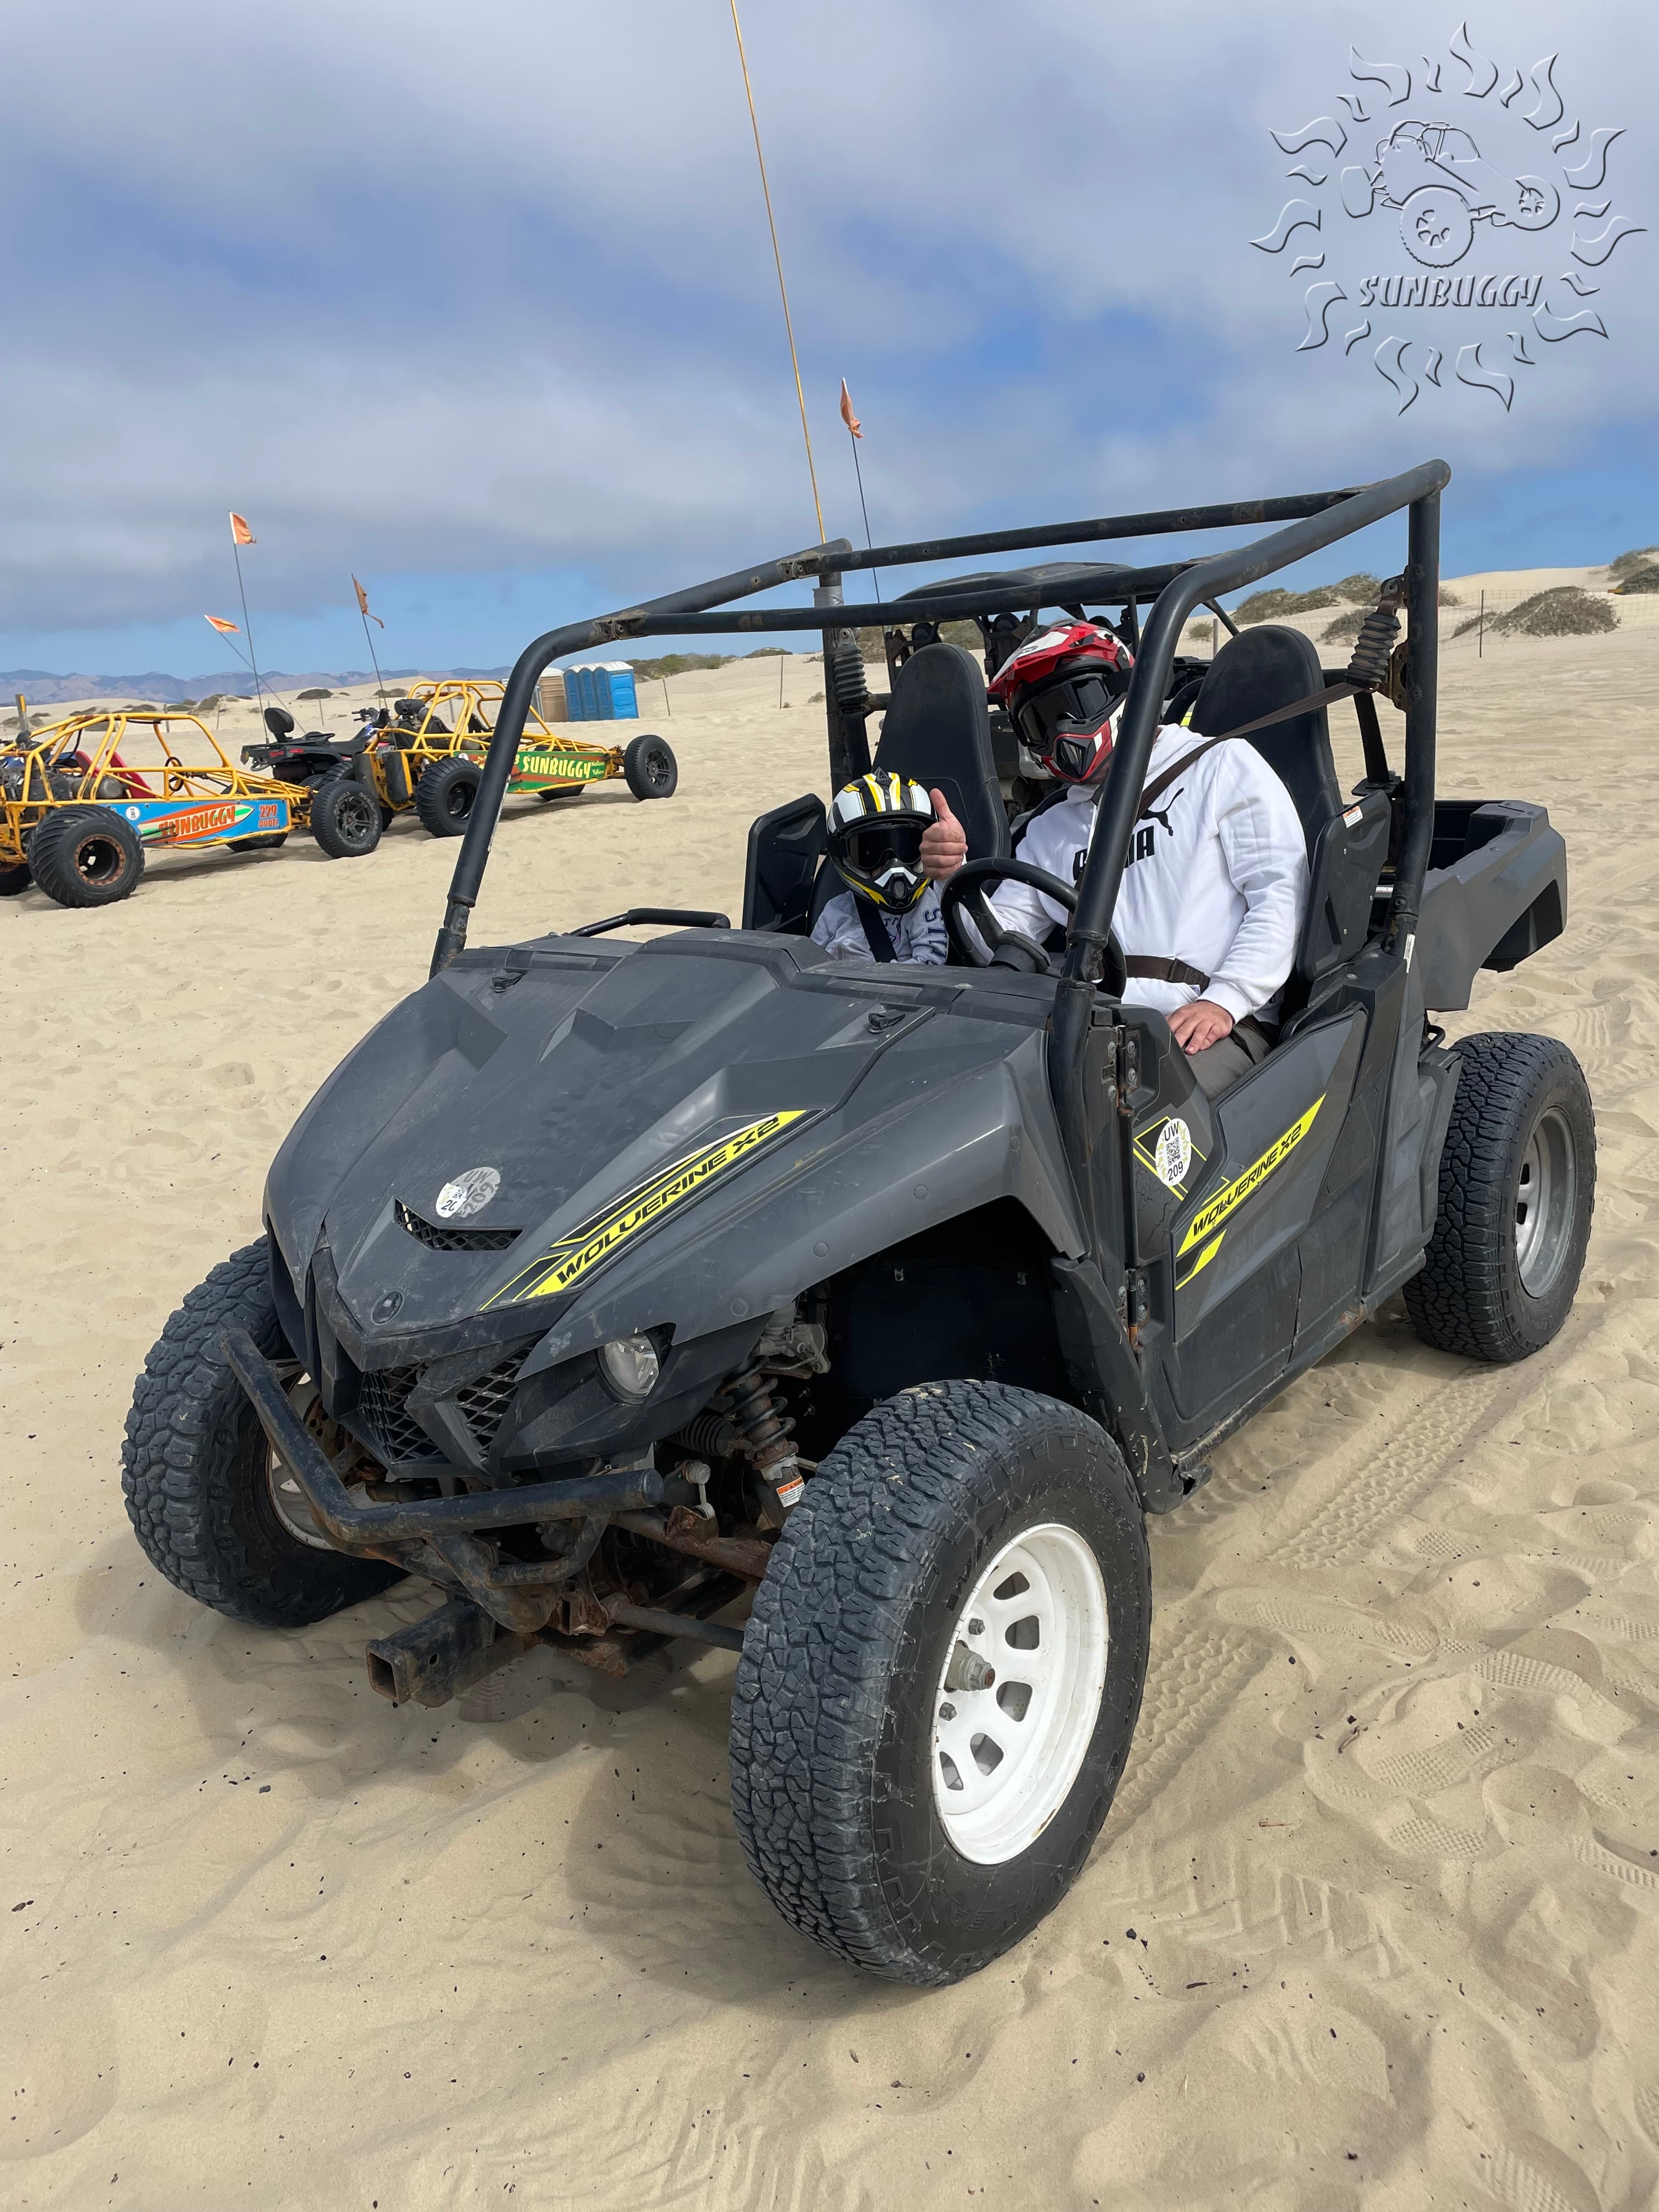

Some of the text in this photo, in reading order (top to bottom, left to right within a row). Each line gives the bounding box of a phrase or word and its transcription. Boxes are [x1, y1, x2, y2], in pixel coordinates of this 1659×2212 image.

[522, 755, 591, 779] SUNBUGGY
[1073, 826, 1155, 881] PA
[1164, 1121, 1178, 1142] UW
[1167, 1160, 1183, 1182] 209
[1193, 1123, 1302, 1237] WOLVERINE X2
[556, 1116, 780, 1285] WOLVERINE X2
